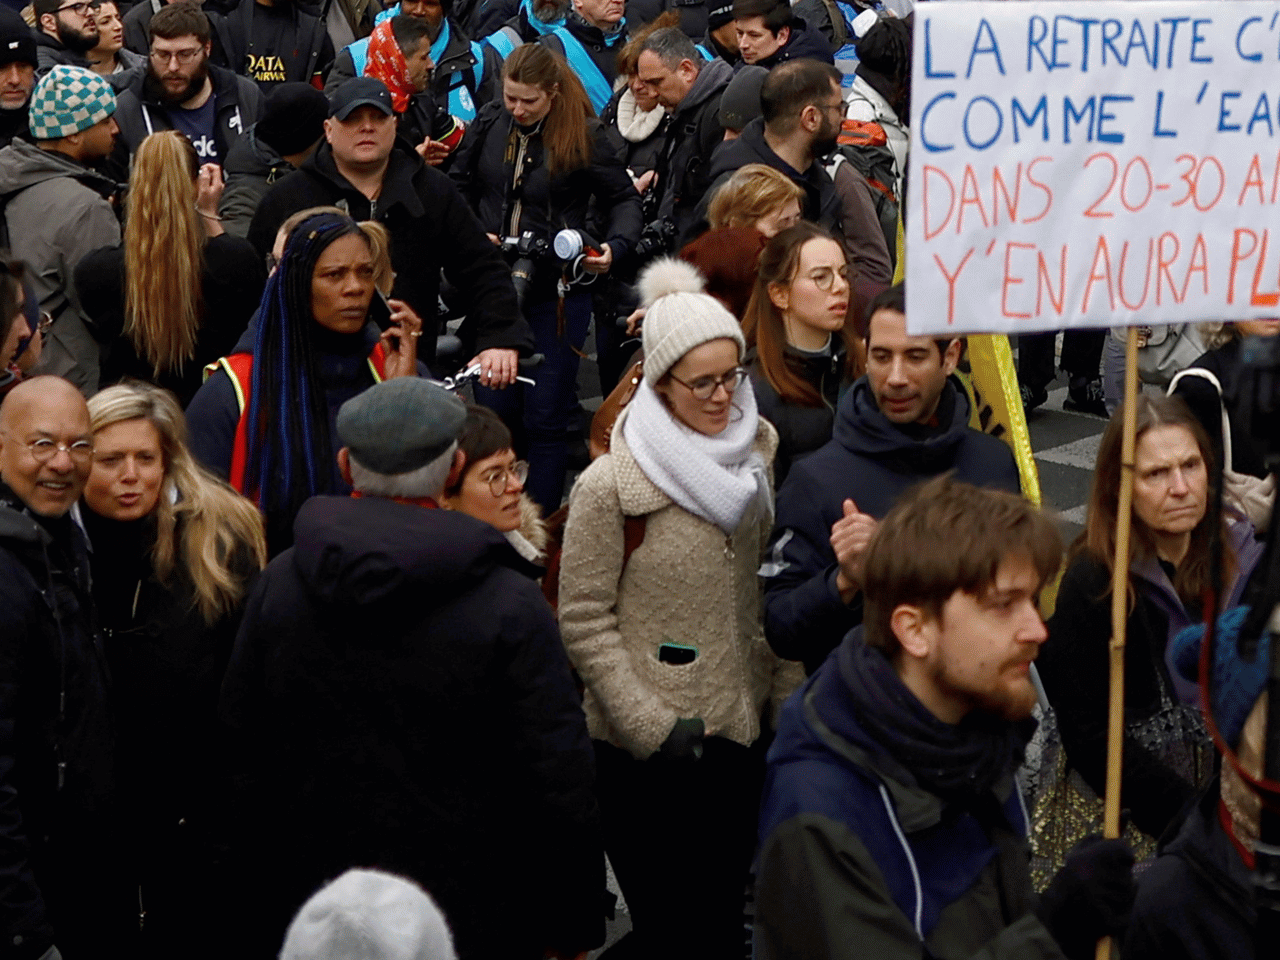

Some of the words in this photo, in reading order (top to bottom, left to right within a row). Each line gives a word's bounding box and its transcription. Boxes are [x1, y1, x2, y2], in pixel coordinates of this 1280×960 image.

[924, 17, 1005, 80] LA
[1027, 15, 1214, 72] RETRAITE
[920, 90, 1133, 152] COMME
[922, 156, 1054, 241] DANS
[1082, 152, 1227, 218] 20-30
[933, 237, 1069, 326] Y'EN
[1081, 231, 1210, 314] AURA
